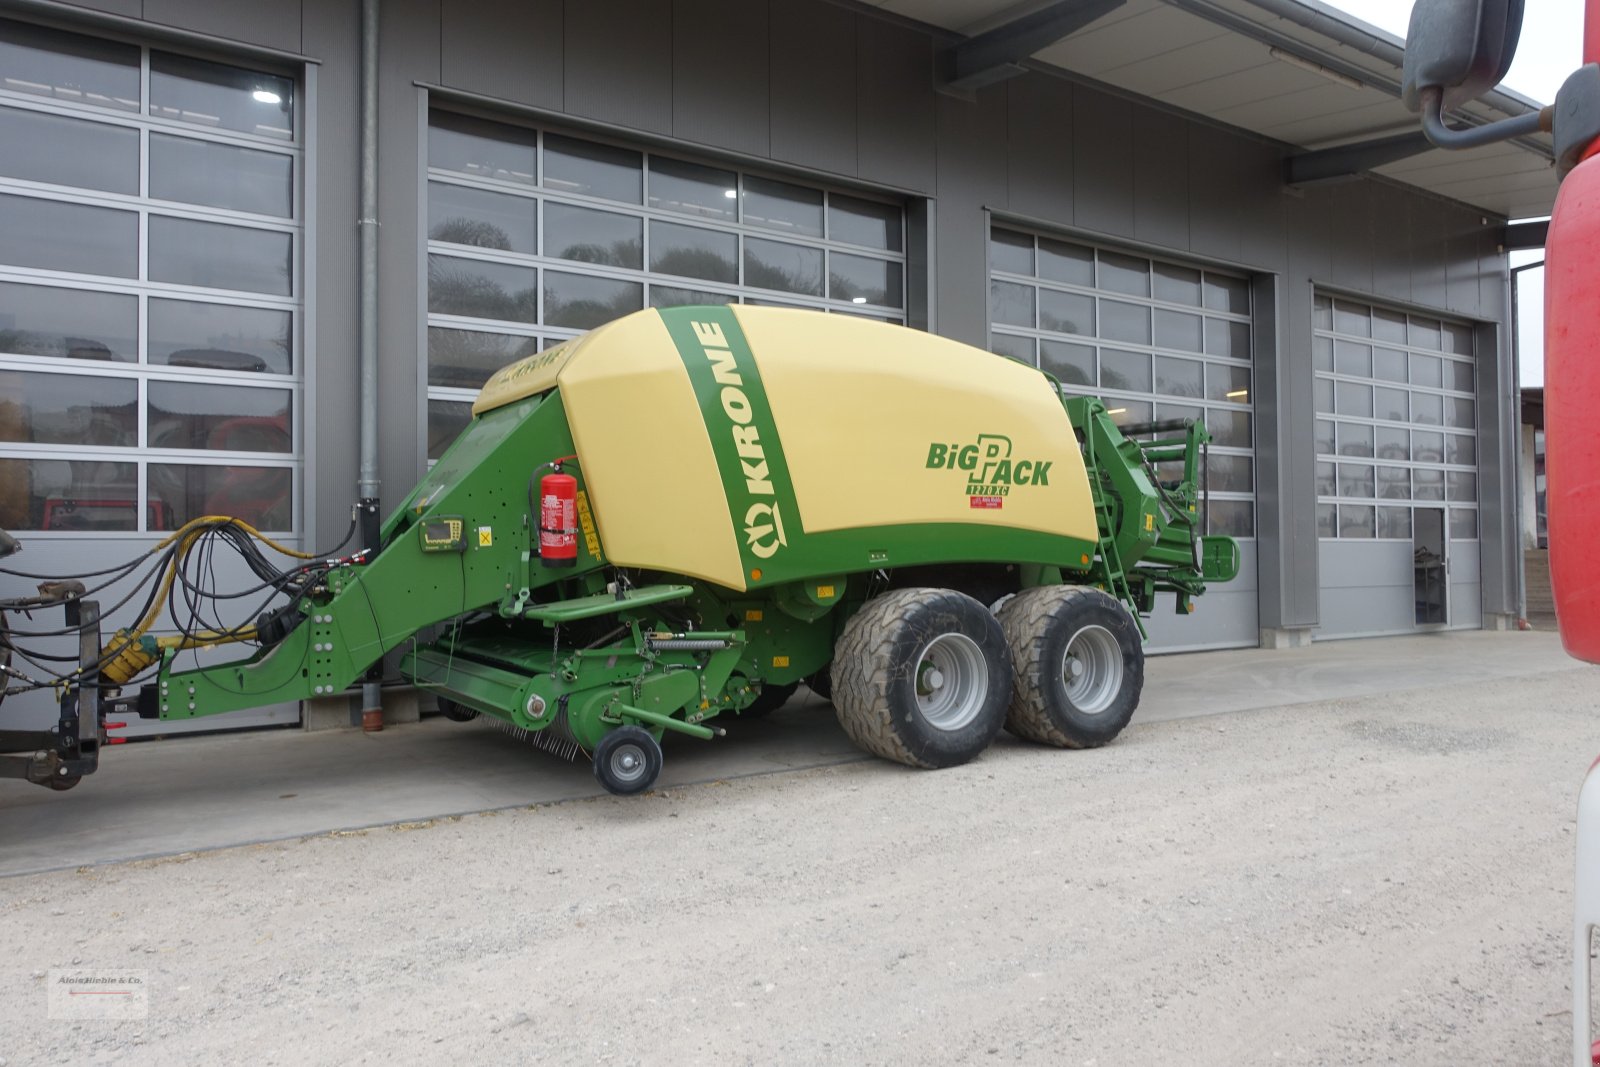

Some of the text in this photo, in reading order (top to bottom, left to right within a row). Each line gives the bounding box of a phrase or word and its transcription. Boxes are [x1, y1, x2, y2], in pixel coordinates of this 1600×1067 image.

[691, 321, 775, 495] KRONE
[968, 434, 1053, 486] PACK
[970, 485, 993, 495] 1270
